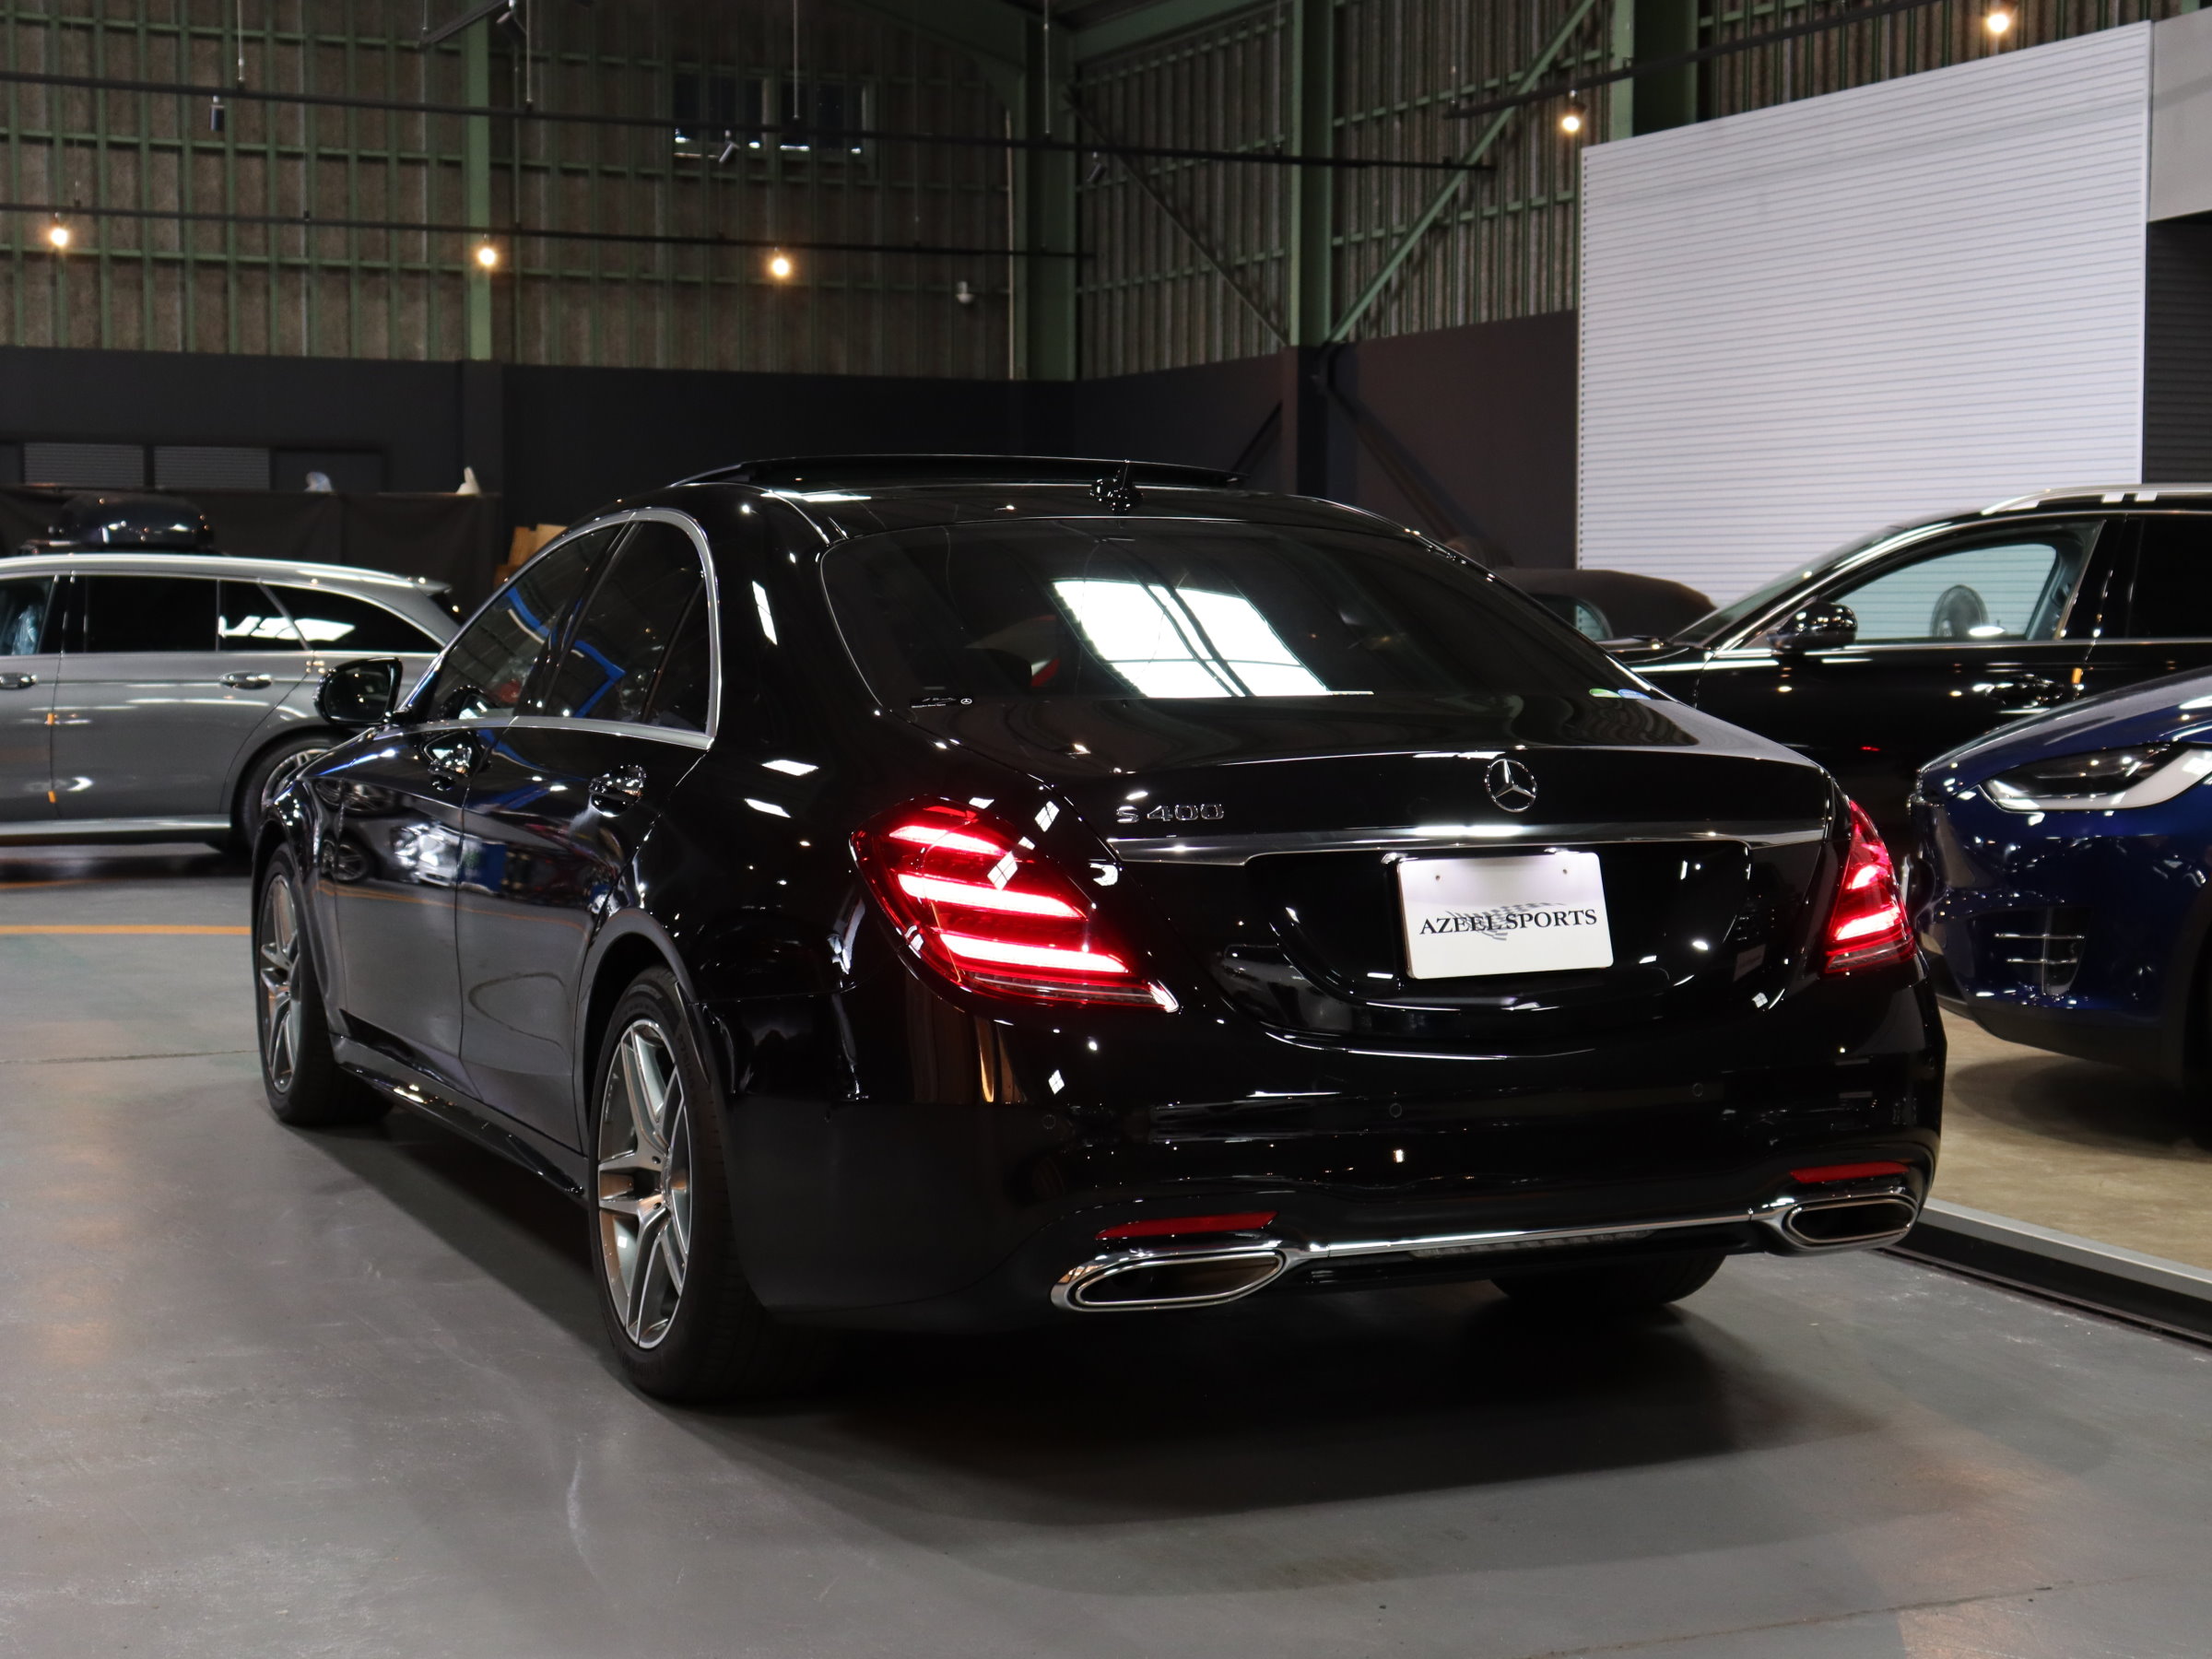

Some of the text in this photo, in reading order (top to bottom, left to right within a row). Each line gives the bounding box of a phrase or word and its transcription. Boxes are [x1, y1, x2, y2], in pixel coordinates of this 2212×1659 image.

[1116, 804, 1224, 823] S 400
[1419, 909, 1597, 935] AZEEL SPORTS
